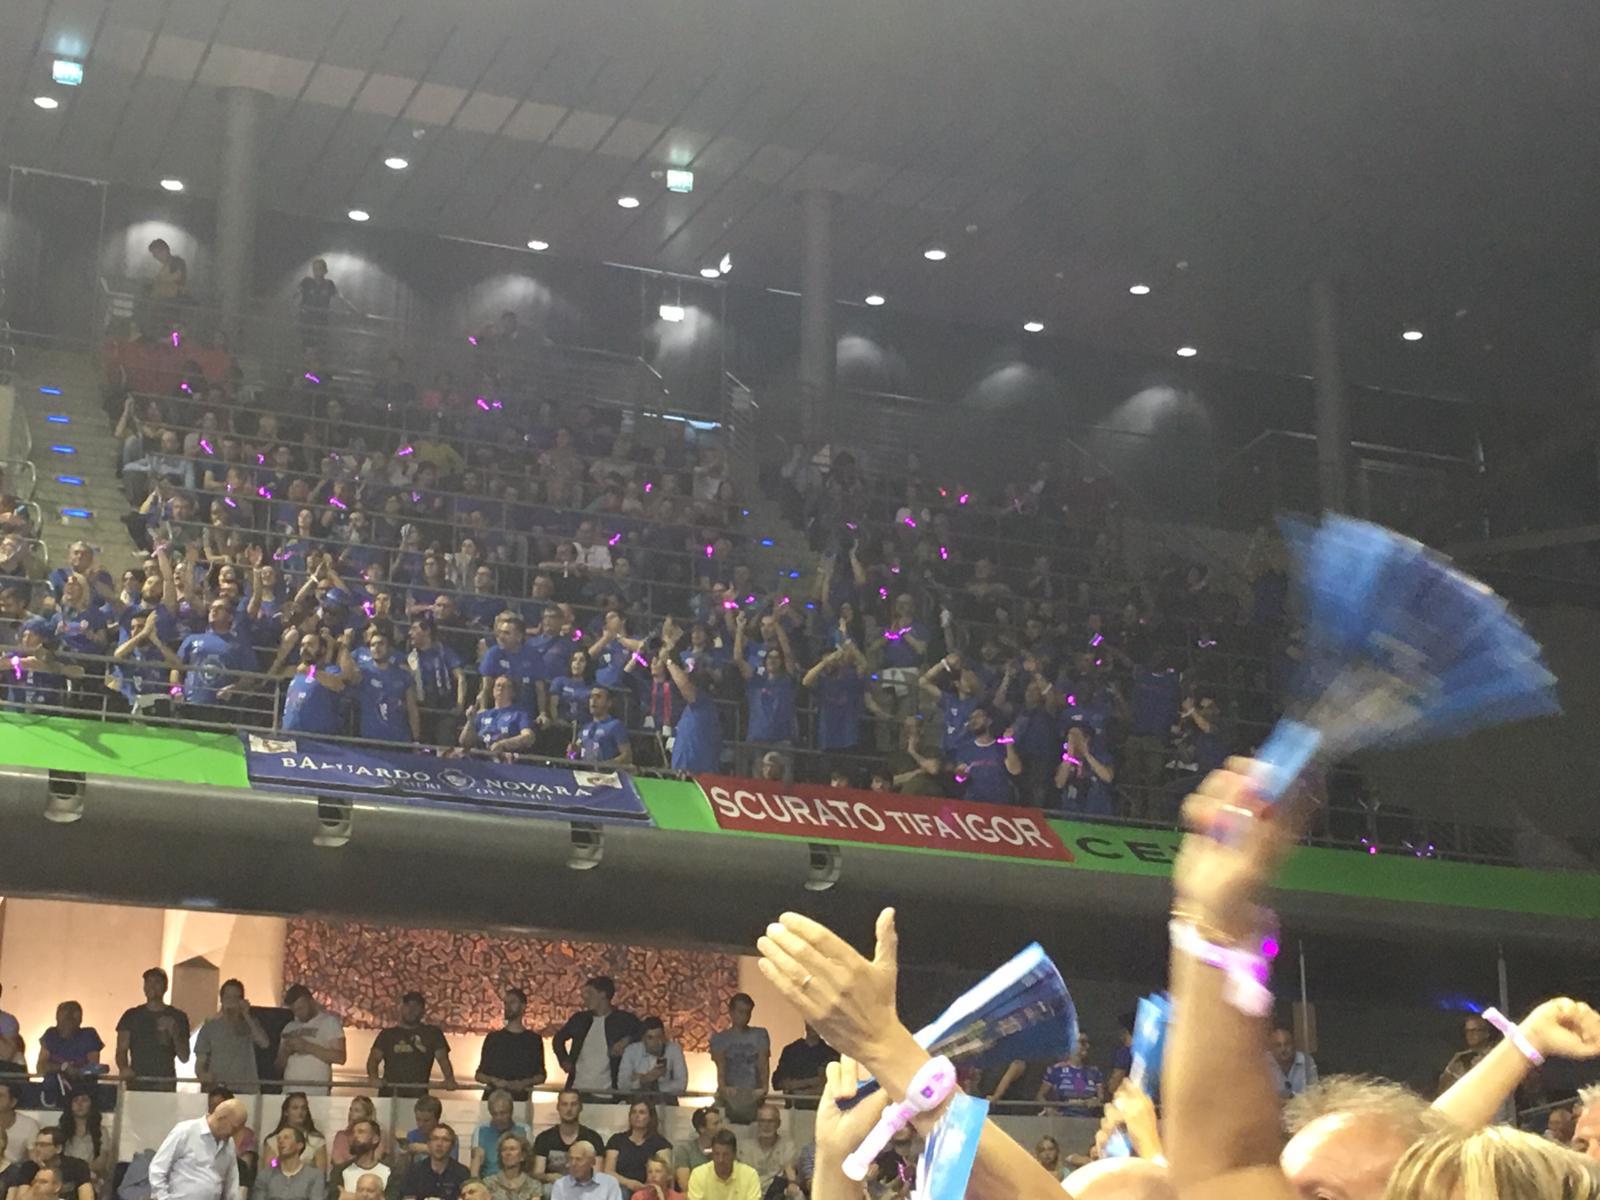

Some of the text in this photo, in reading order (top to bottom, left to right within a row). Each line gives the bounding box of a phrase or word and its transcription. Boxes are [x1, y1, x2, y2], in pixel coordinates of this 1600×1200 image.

[485, 779, 592, 797] NOVARA
[710, 786, 1054, 849] SCURATO TIFA IGOR
[1075, 836, 1181, 865] CE
